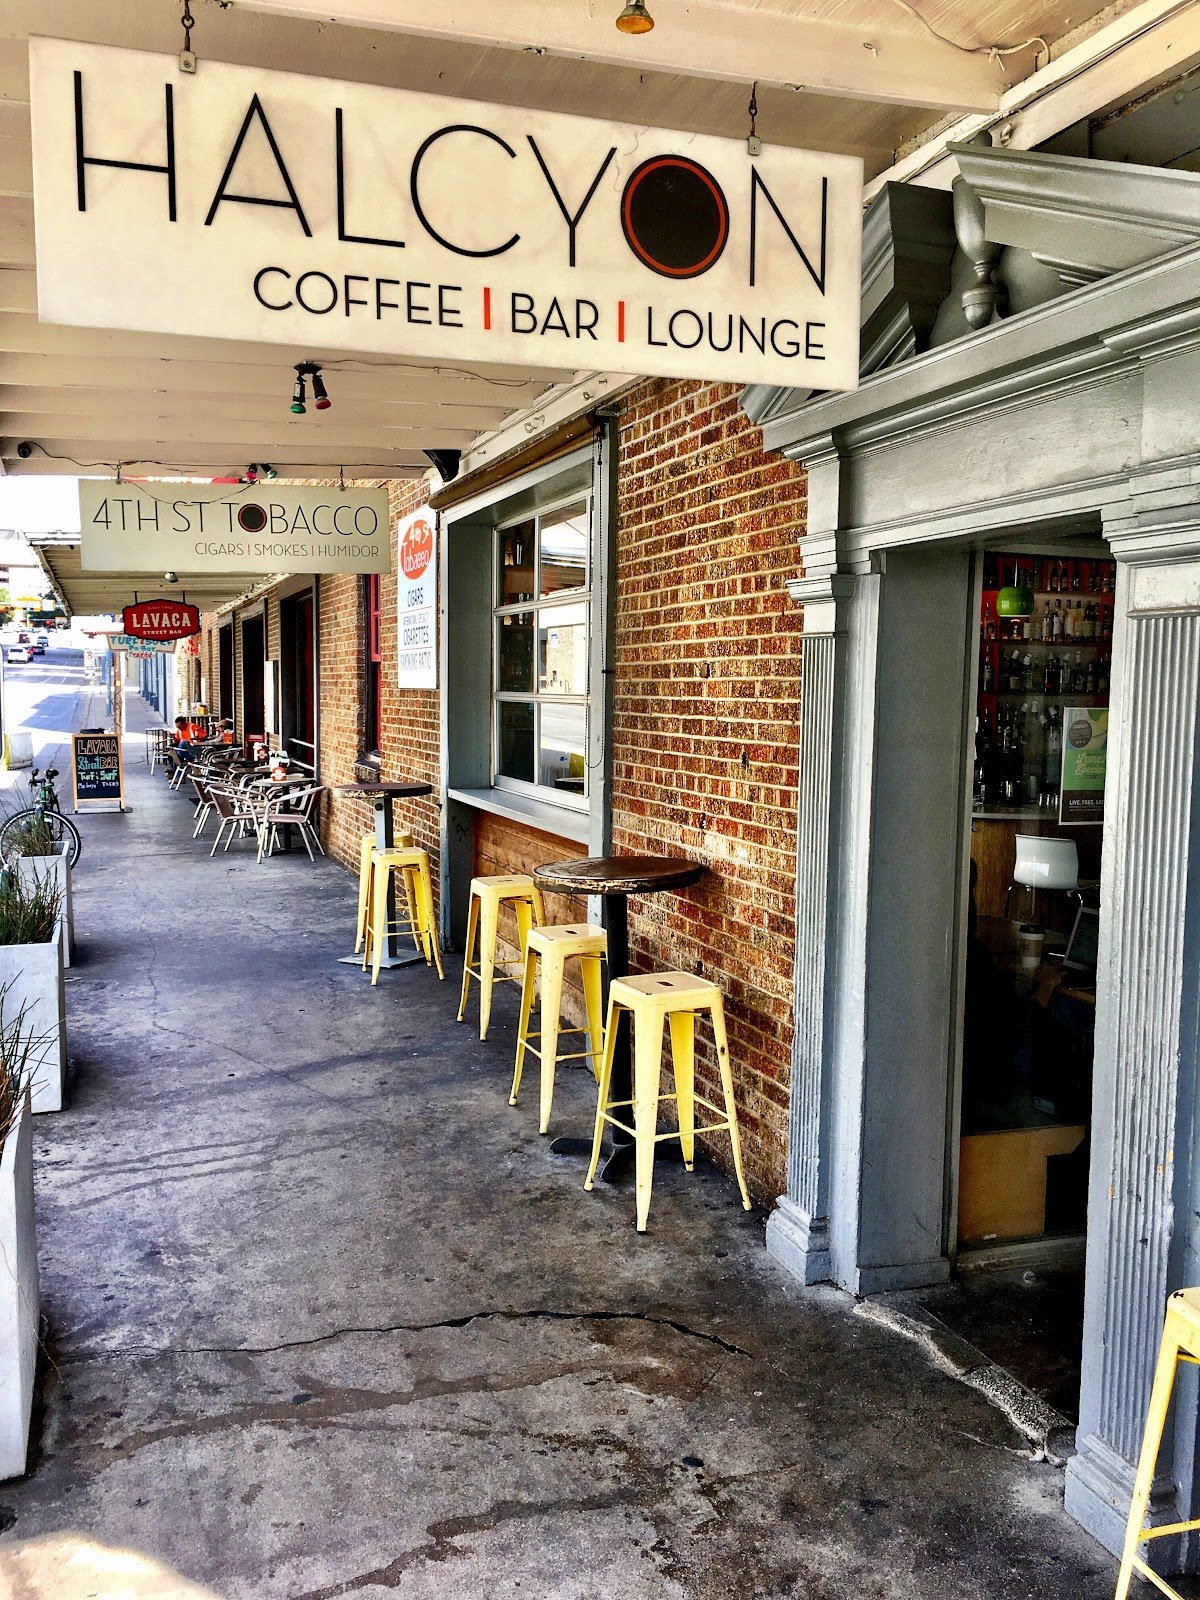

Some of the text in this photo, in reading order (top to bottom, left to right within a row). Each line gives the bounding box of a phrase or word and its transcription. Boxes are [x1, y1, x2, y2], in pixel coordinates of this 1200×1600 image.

[74, 70, 828, 296] HALCYON
[253, 266, 826, 361] COFFEE BAR LOUNGE
[93, 498, 378, 536] 4TH ST TOBACCO
[195, 542, 379, 557] CIGARS SMOKES HUMIDOR
[407, 587, 424, 608] CIGARS
[133, 613, 191, 628] LAVACA
[403, 625, 429, 646] CIGARETTES
[1076, 752, 1105, 764] Lunc
